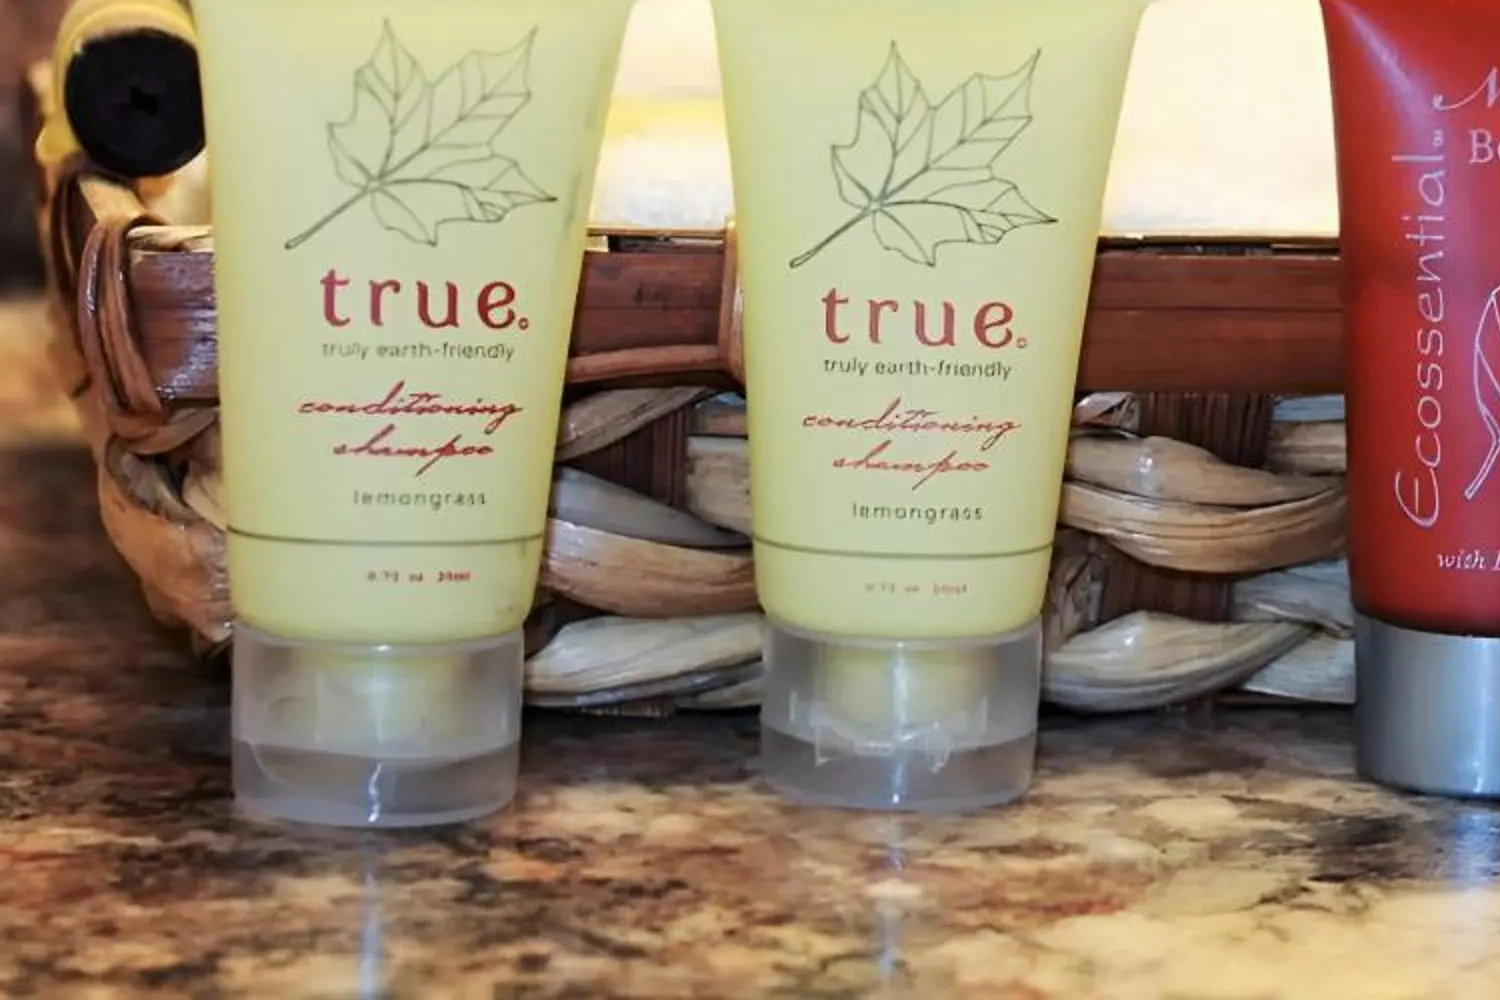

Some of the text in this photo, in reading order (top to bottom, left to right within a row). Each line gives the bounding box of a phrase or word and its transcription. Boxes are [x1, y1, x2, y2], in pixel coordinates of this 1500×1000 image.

[321, 342, 515, 362] truly earth-friendly
[1393, 151, 1447, 529] Ecossential
[823, 358, 1012, 381] truly earth-friendly
[297, 379, 522, 435] conditioning
[801, 397, 1021, 452] conditioning
[332, 423, 495, 477] shampoo
[831, 439, 990, 491] shampoo
[353, 489, 487, 511] lemongrass
[851, 502, 984, 525] lemongrass
[1437, 549, 1487, 571] with
